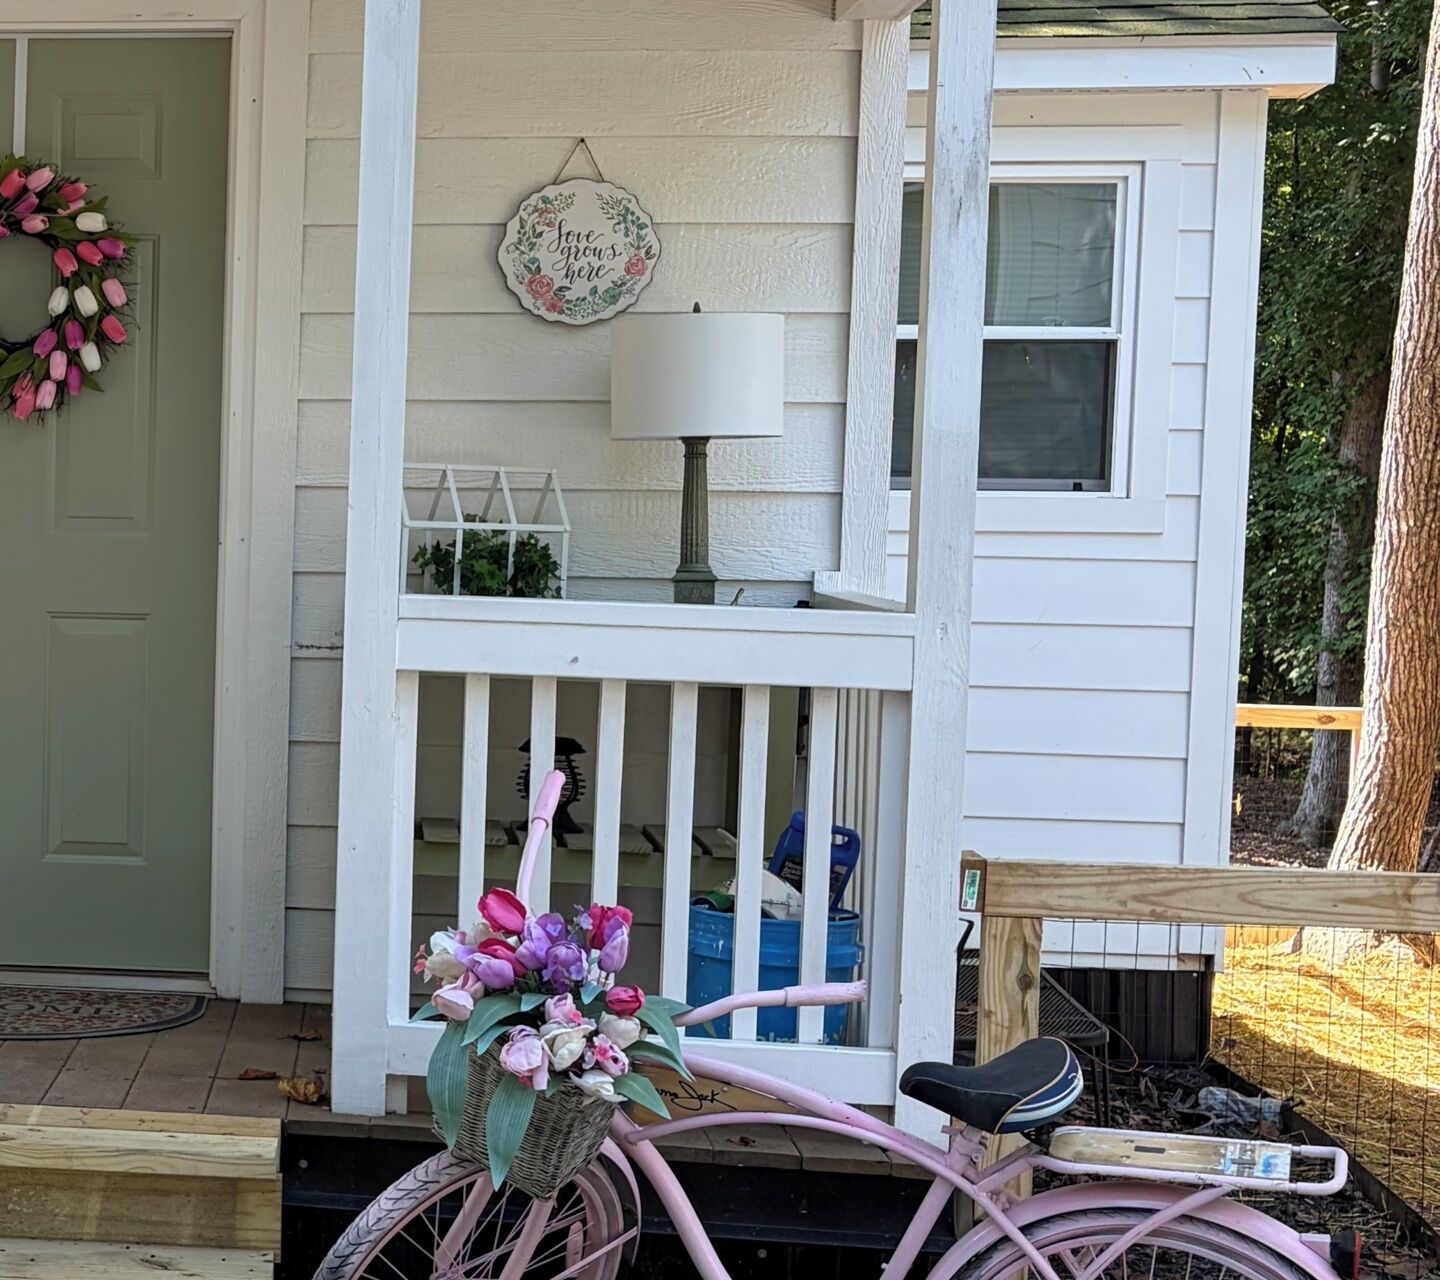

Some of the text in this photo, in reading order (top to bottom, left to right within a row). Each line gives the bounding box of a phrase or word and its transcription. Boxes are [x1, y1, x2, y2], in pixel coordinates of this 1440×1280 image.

[551, 243, 622, 272] grows
[561, 261, 615, 285] here
[671, 1080, 738, 1111] Jack
